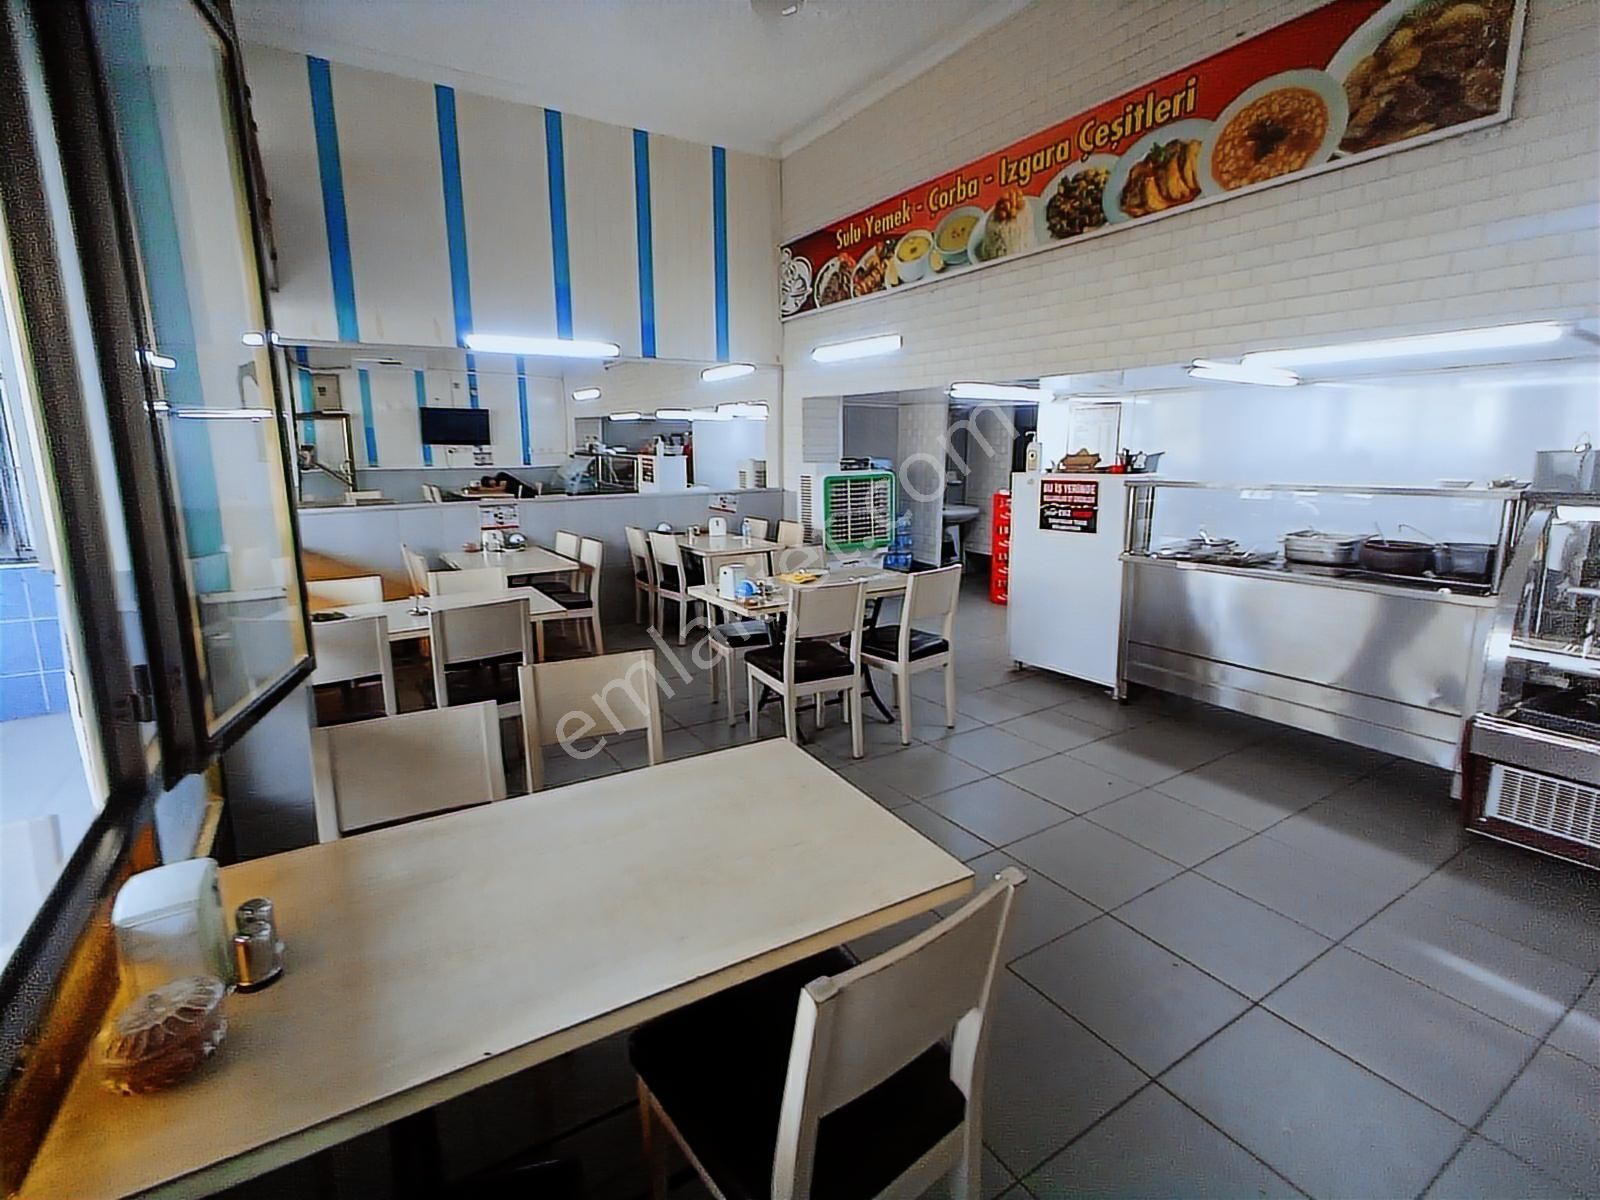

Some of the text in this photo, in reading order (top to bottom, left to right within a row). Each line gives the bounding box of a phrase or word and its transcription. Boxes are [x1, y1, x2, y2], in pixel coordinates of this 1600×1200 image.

[835, 221, 862, 250] Sulu
[865, 201, 911, 238] Yemek
[928, 176, 978, 218] Çorba
[1000, 139, 1070, 187] Izgara
[1079, 78, 1197, 161] Çeşitleri
